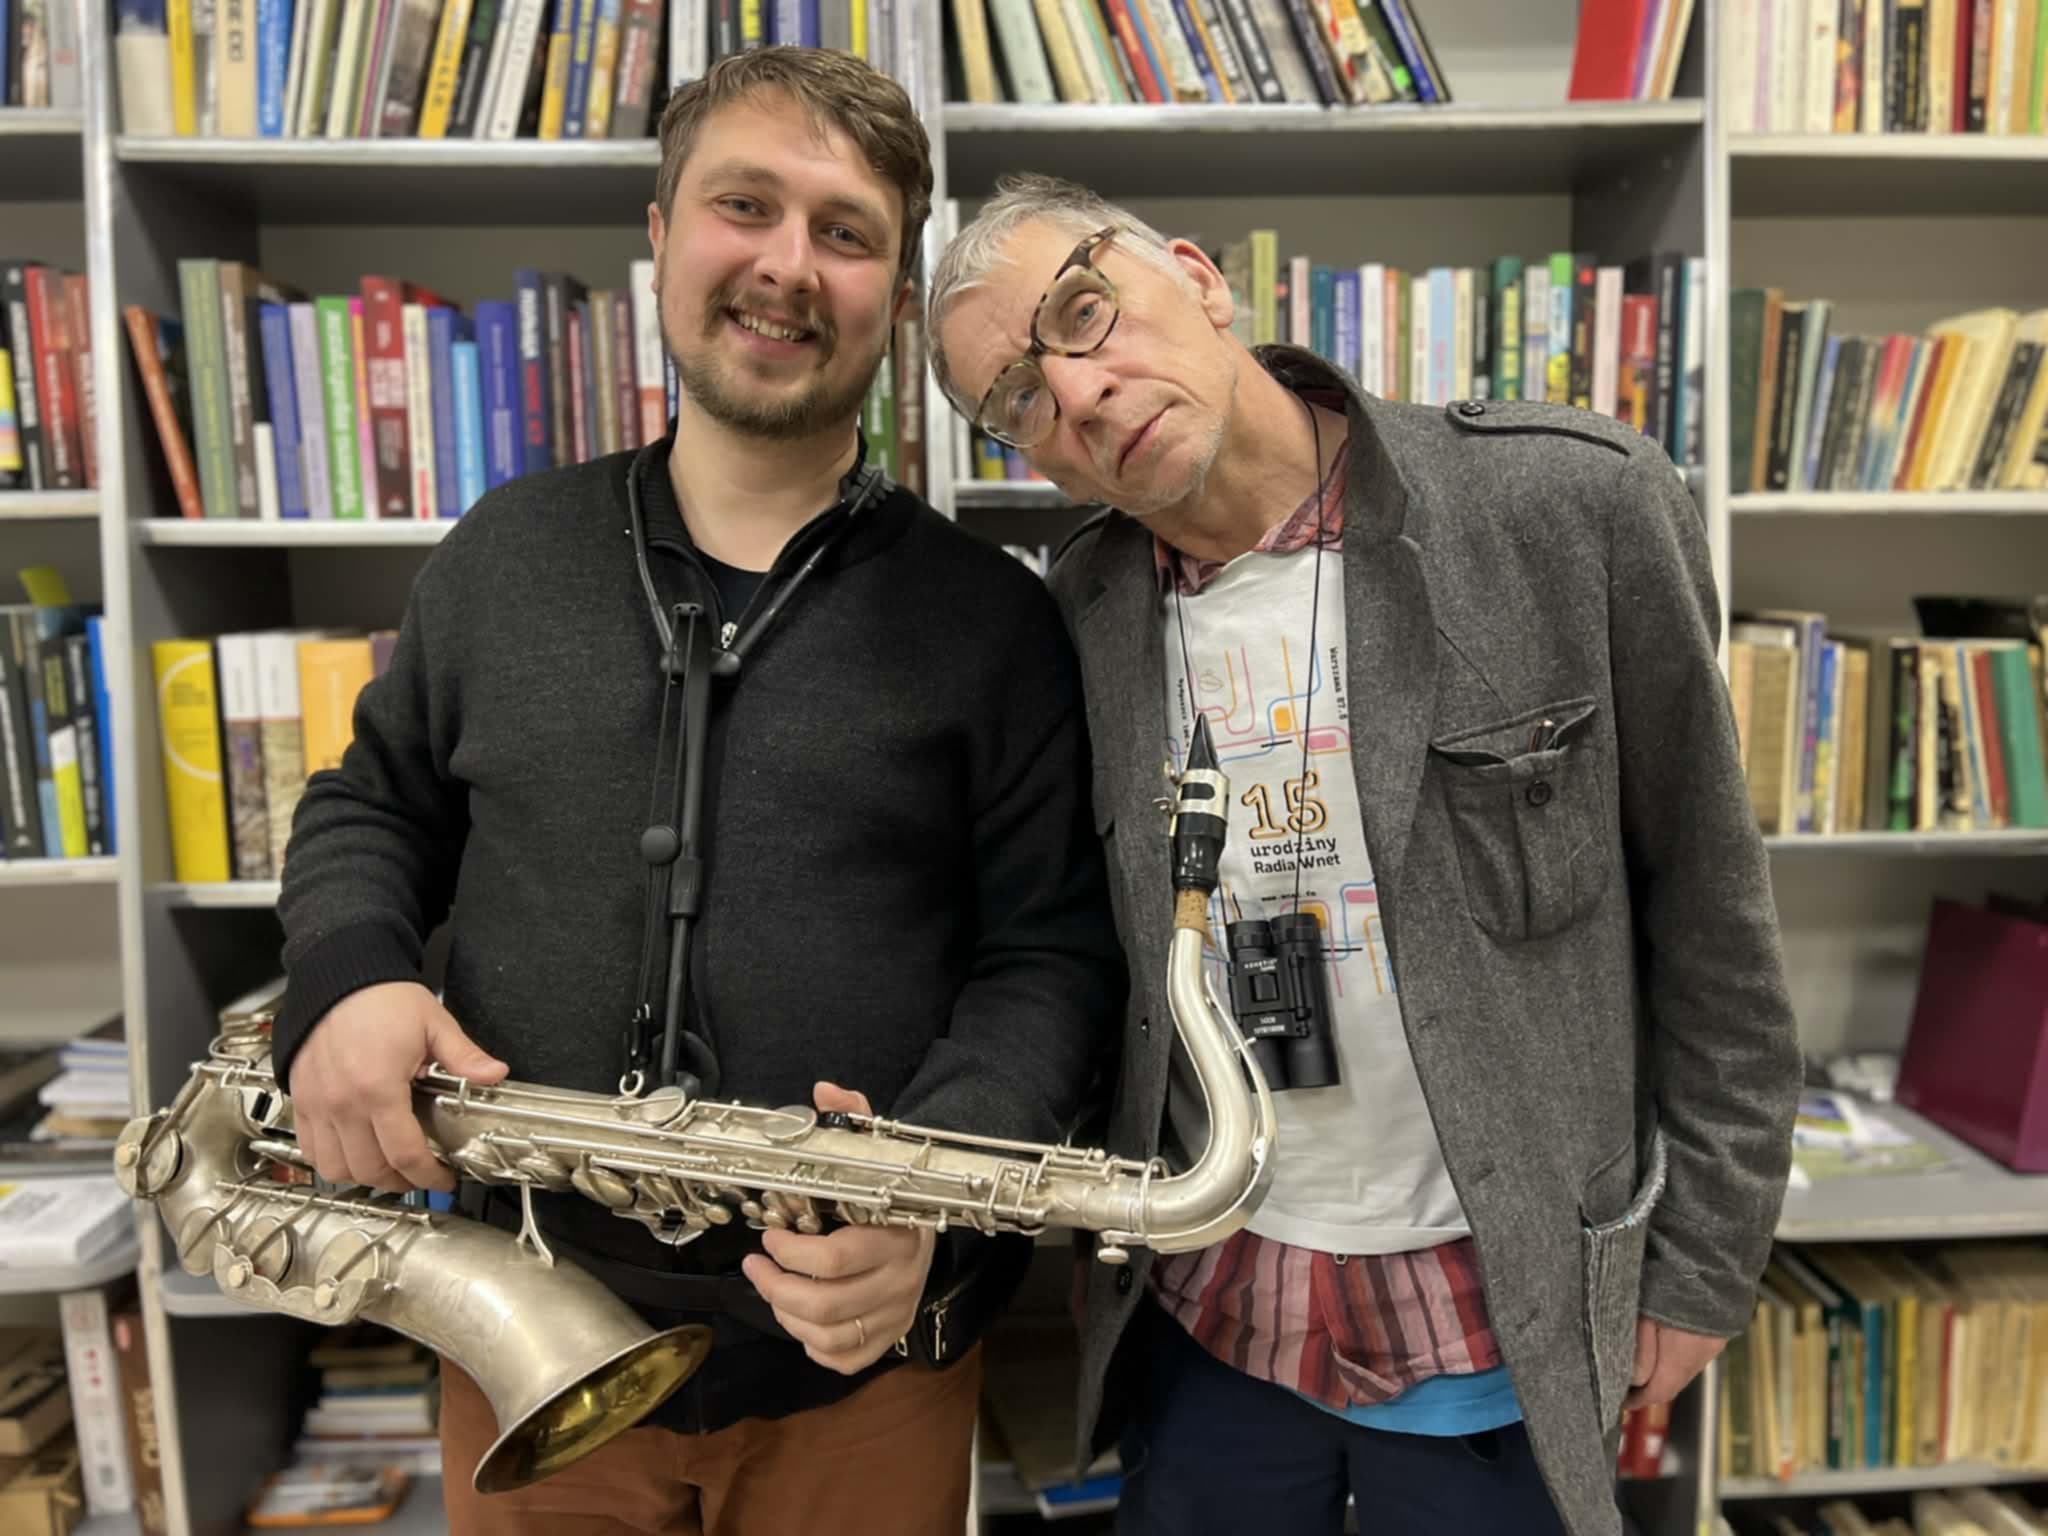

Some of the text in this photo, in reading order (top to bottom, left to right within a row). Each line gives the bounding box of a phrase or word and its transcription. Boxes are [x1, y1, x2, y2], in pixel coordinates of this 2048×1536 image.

[1240, 770, 1329, 840] 15
[1250, 836, 1337, 857] urodziny
[1254, 853, 1342, 873] Radia Wnet
